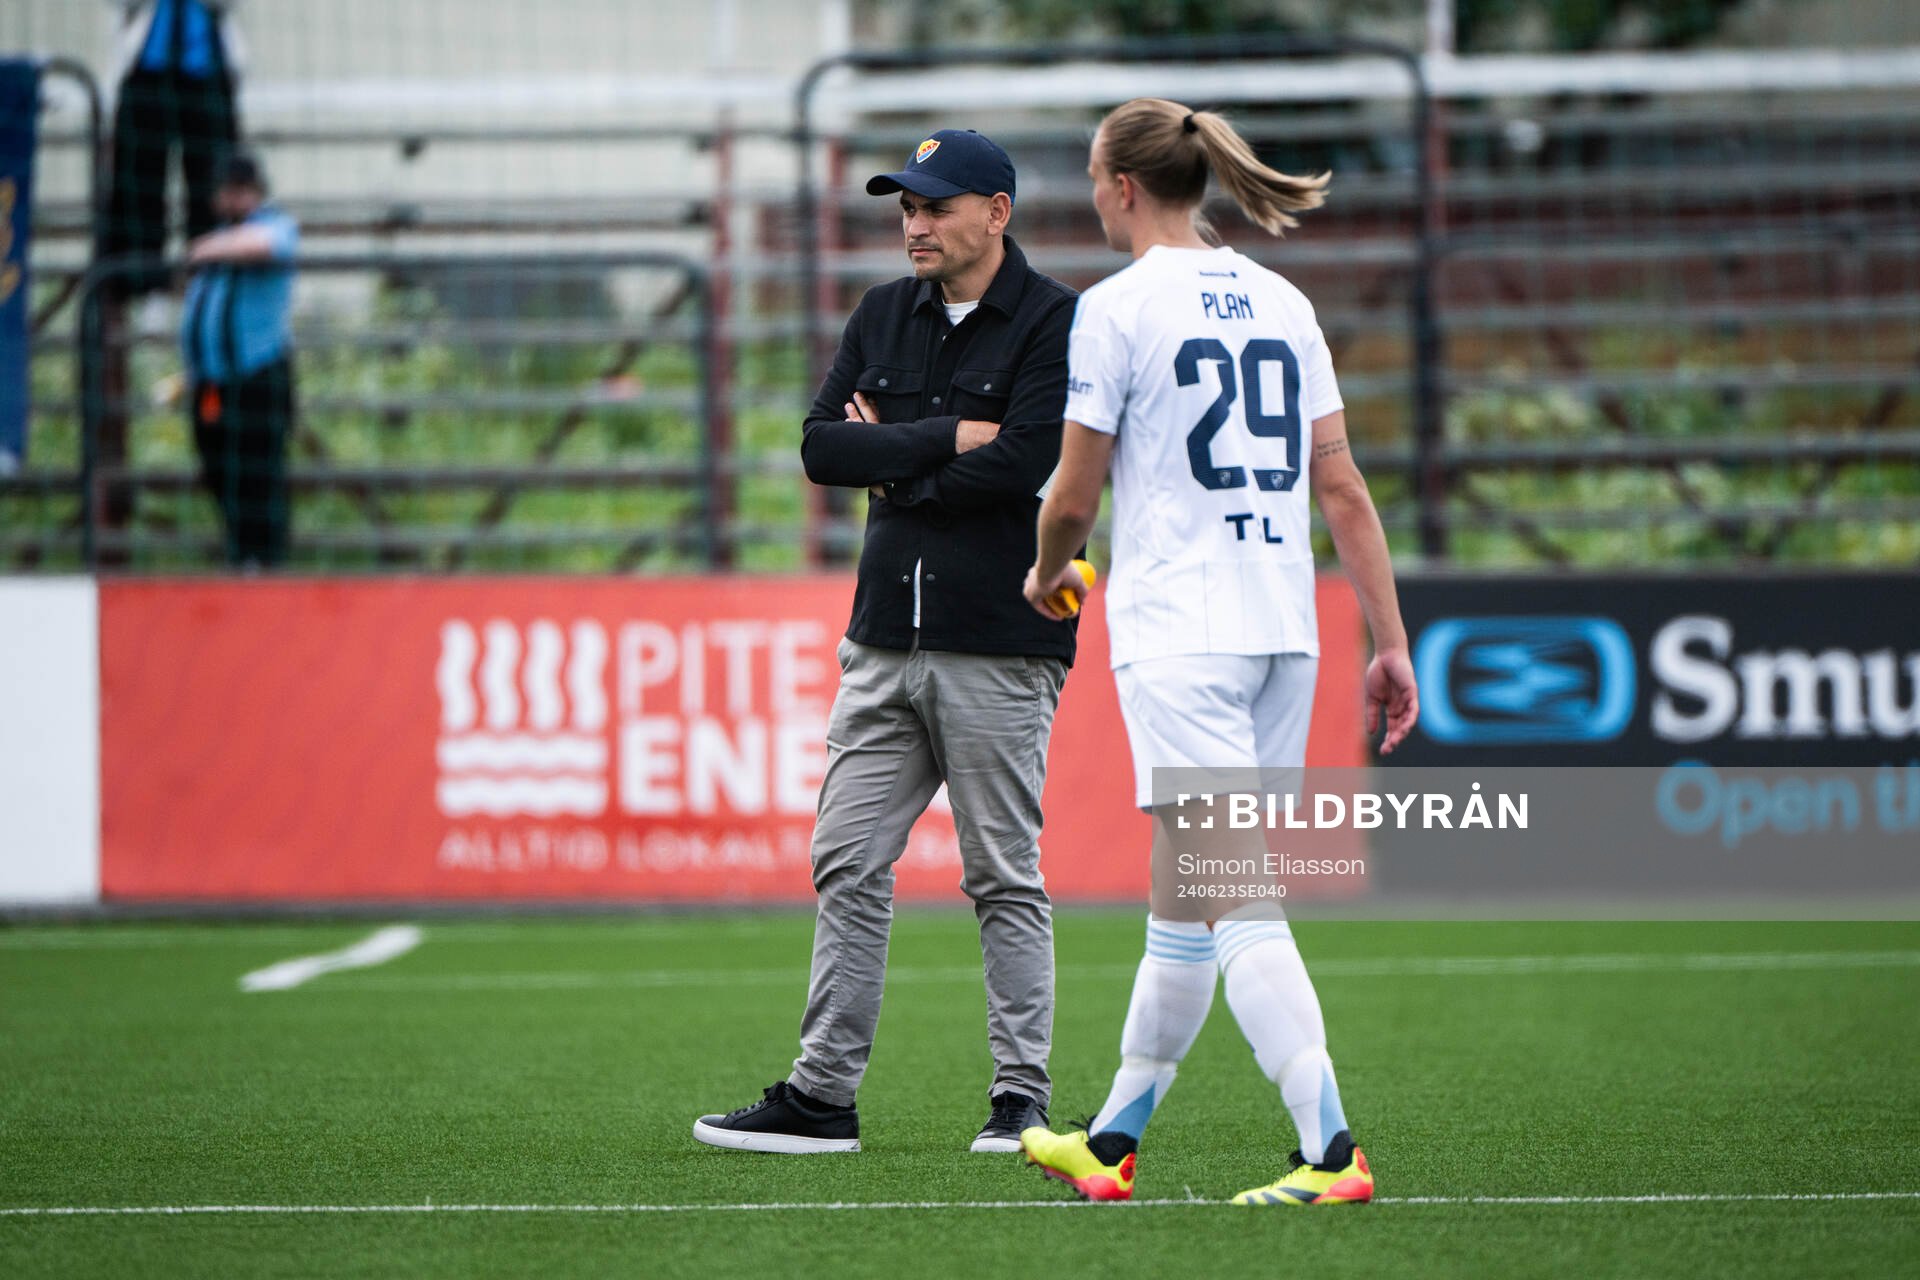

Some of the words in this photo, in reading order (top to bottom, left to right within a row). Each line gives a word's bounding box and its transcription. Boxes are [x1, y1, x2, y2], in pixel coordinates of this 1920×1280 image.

[1201, 292, 1254, 320] PLAN
[1174, 337, 1301, 492] 29
[1225, 512, 1283, 544] TL
[617, 619, 828, 713] PITE
[1649, 611, 1920, 745] Smu
[1655, 758, 1862, 850] Open
